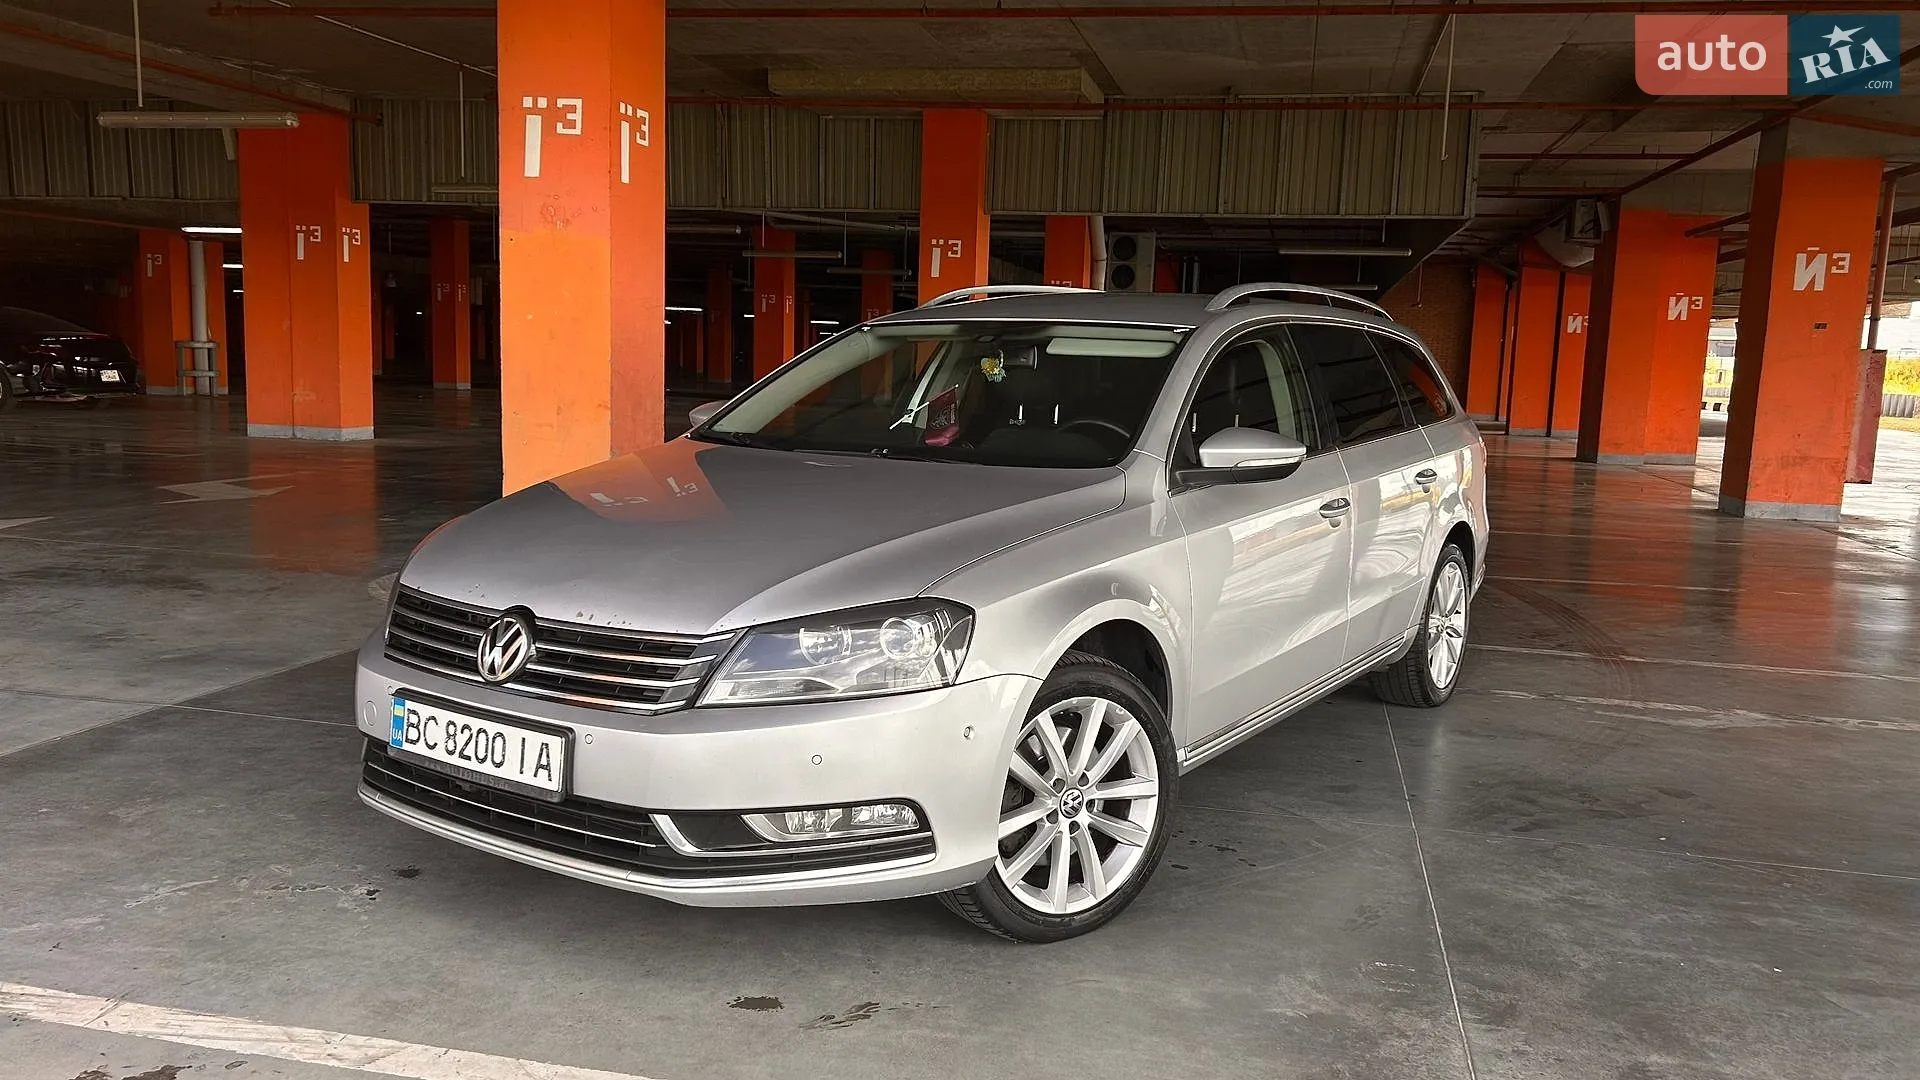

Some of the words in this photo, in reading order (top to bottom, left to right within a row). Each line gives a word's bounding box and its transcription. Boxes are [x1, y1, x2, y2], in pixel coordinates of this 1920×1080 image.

[392, 727, 402, 741] UA
[405, 708, 439, 750] BC
[444, 720, 506, 768] 8200
